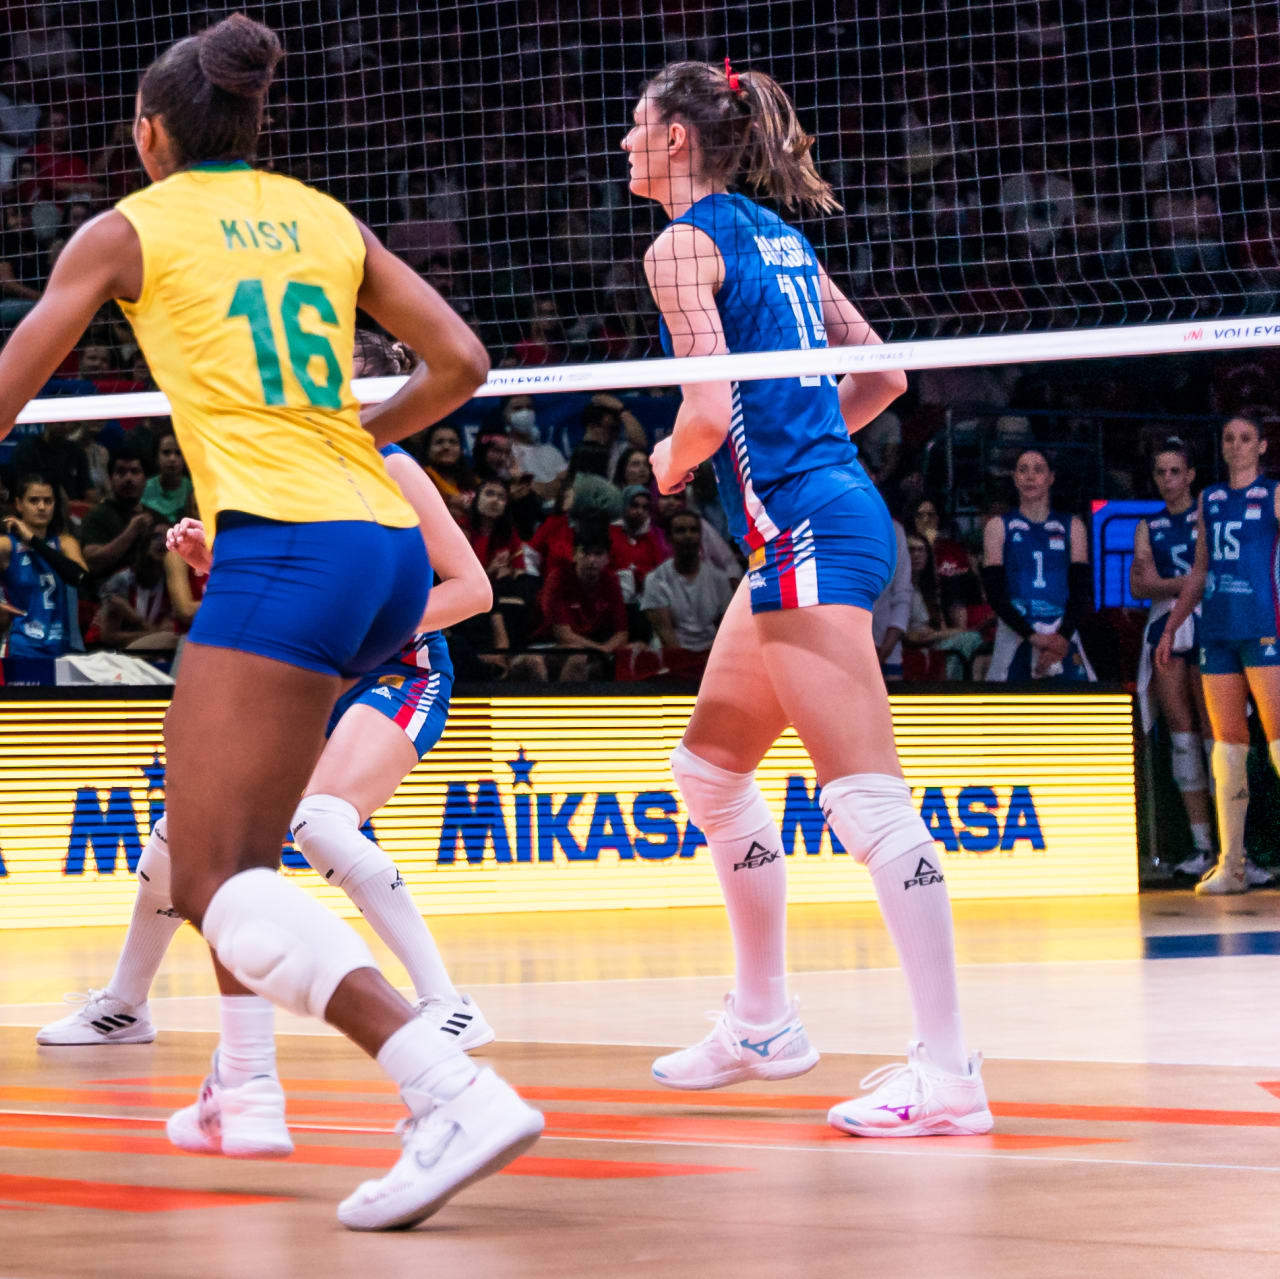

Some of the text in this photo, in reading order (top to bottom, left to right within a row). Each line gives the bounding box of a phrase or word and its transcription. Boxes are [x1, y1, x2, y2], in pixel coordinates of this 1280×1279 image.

[221, 220, 301, 253] KISY
[225, 279, 344, 410] 16
[1213, 522, 1242, 560] 15
[1032, 550, 1047, 589] 1
[1171, 544, 1192, 576] 5
[40, 574, 56, 610] 2
[780, 776, 1046, 856] MASA
[733, 849, 780, 871] PEAK
